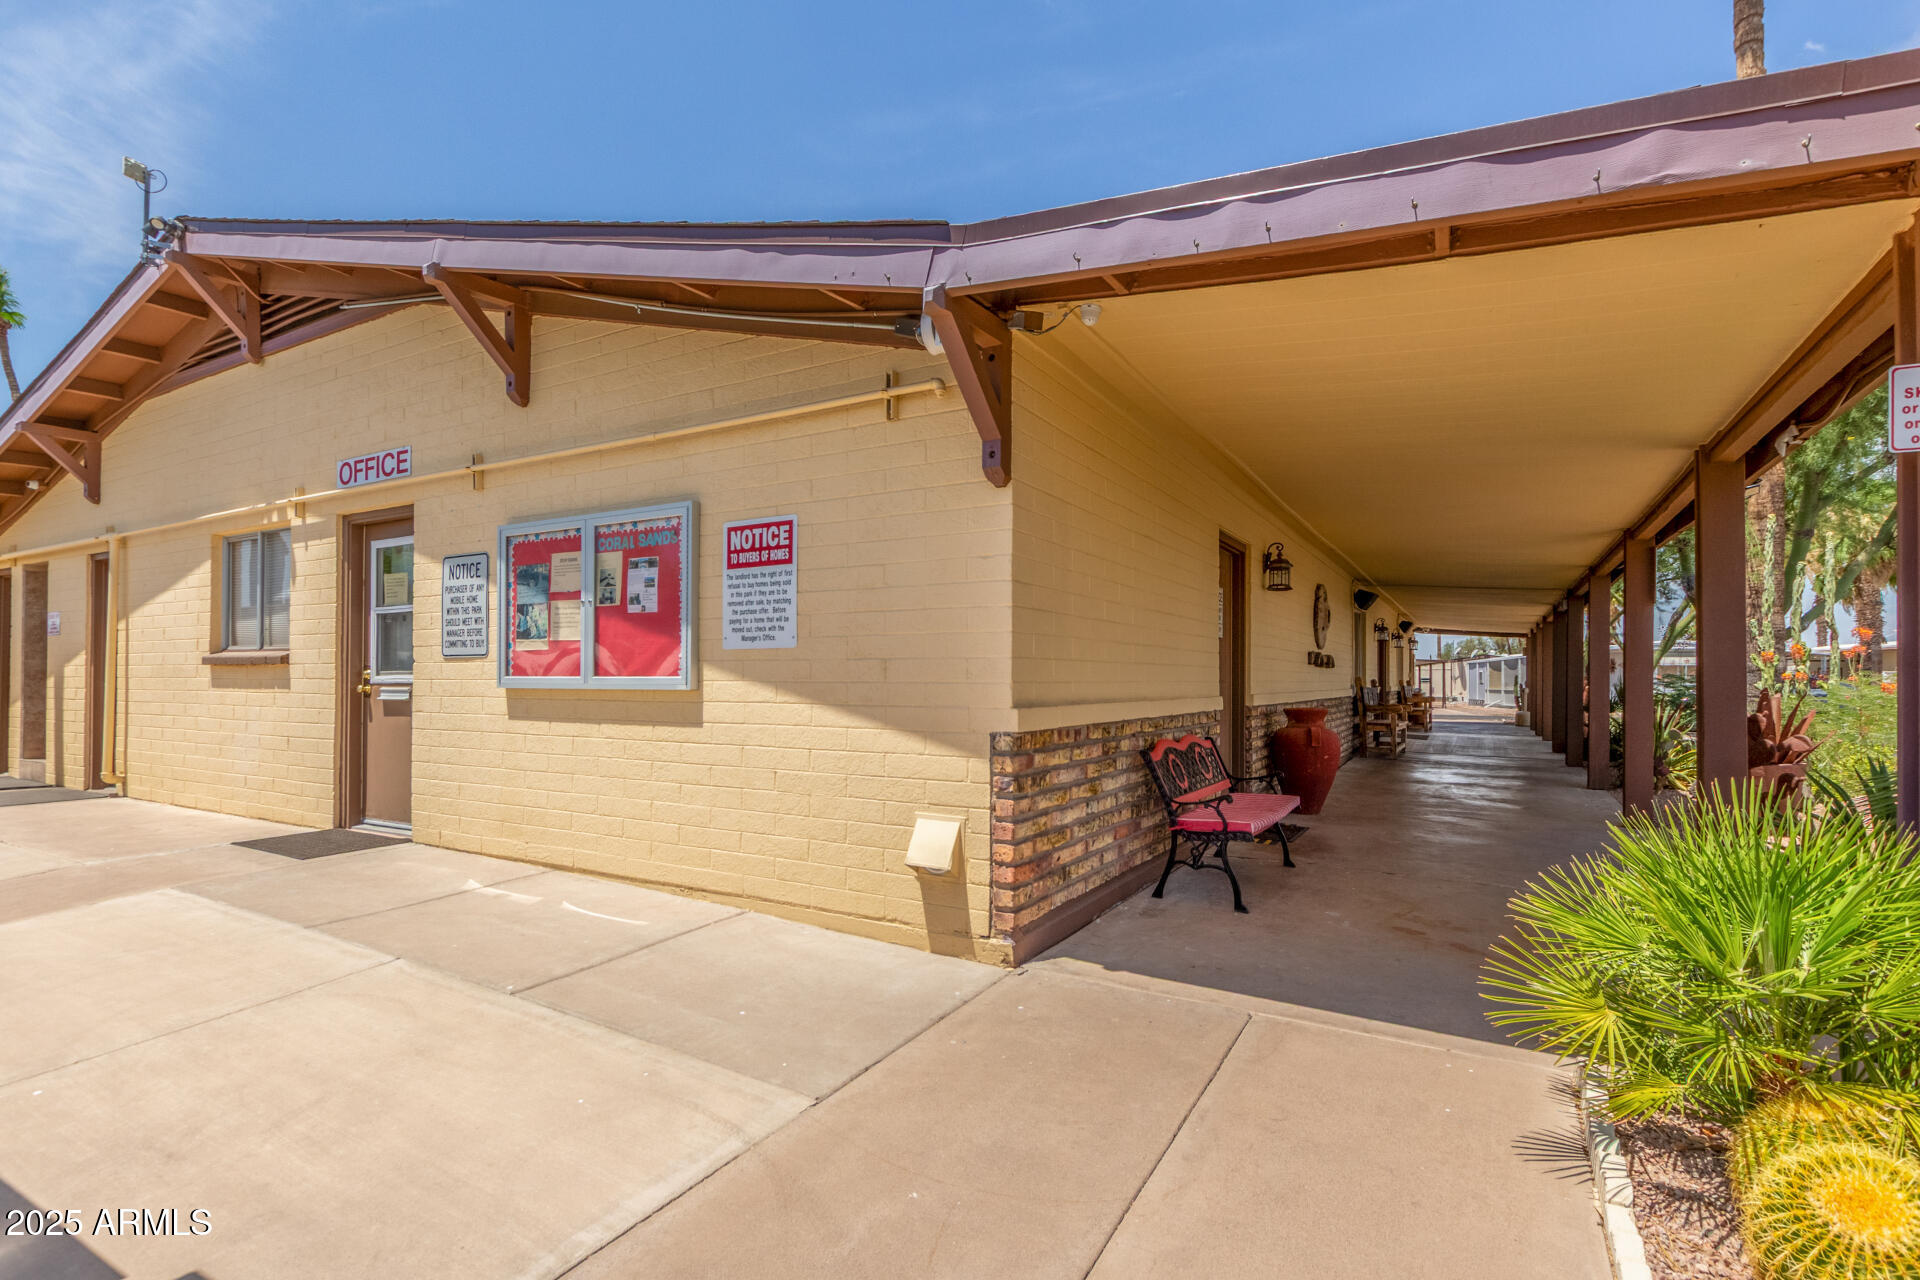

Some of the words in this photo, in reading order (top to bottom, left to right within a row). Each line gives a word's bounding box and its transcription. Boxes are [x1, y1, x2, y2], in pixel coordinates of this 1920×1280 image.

[339, 449, 409, 486] OFFICE
[598, 536, 635, 551] CORAL
[638, 530, 679, 547] SANDS
[731, 525, 790, 551] NOTICE
[730, 553, 738, 565] TO
[739, 551, 760, 564] BUYERS
[761, 550, 769, 562] OF
[770, 548, 790, 561] HOMES
[449, 562, 481, 580] NOTICE
[768, 571, 777, 579] right
[445, 585, 468, 594] PURCHASER
[469, 584, 475, 592] OF
[476, 584, 485, 592] ANY
[450, 596, 465, 604] MOBILE
[467, 595, 479, 603] HOME
[446, 607, 460, 615] WITHIN
[461, 606, 470, 614] THIS
[472, 606, 482, 614] PARK
[445, 618, 460, 626] SHOULD
[462, 617, 473, 626] MEET
[474, 617, 484, 625] WITH
[447, 629, 465, 637] MANAGER
[467, 628, 482, 636] BEFORE
[445, 639, 467, 648] COMMITTING
[741, 635, 761, 643] Manager's
